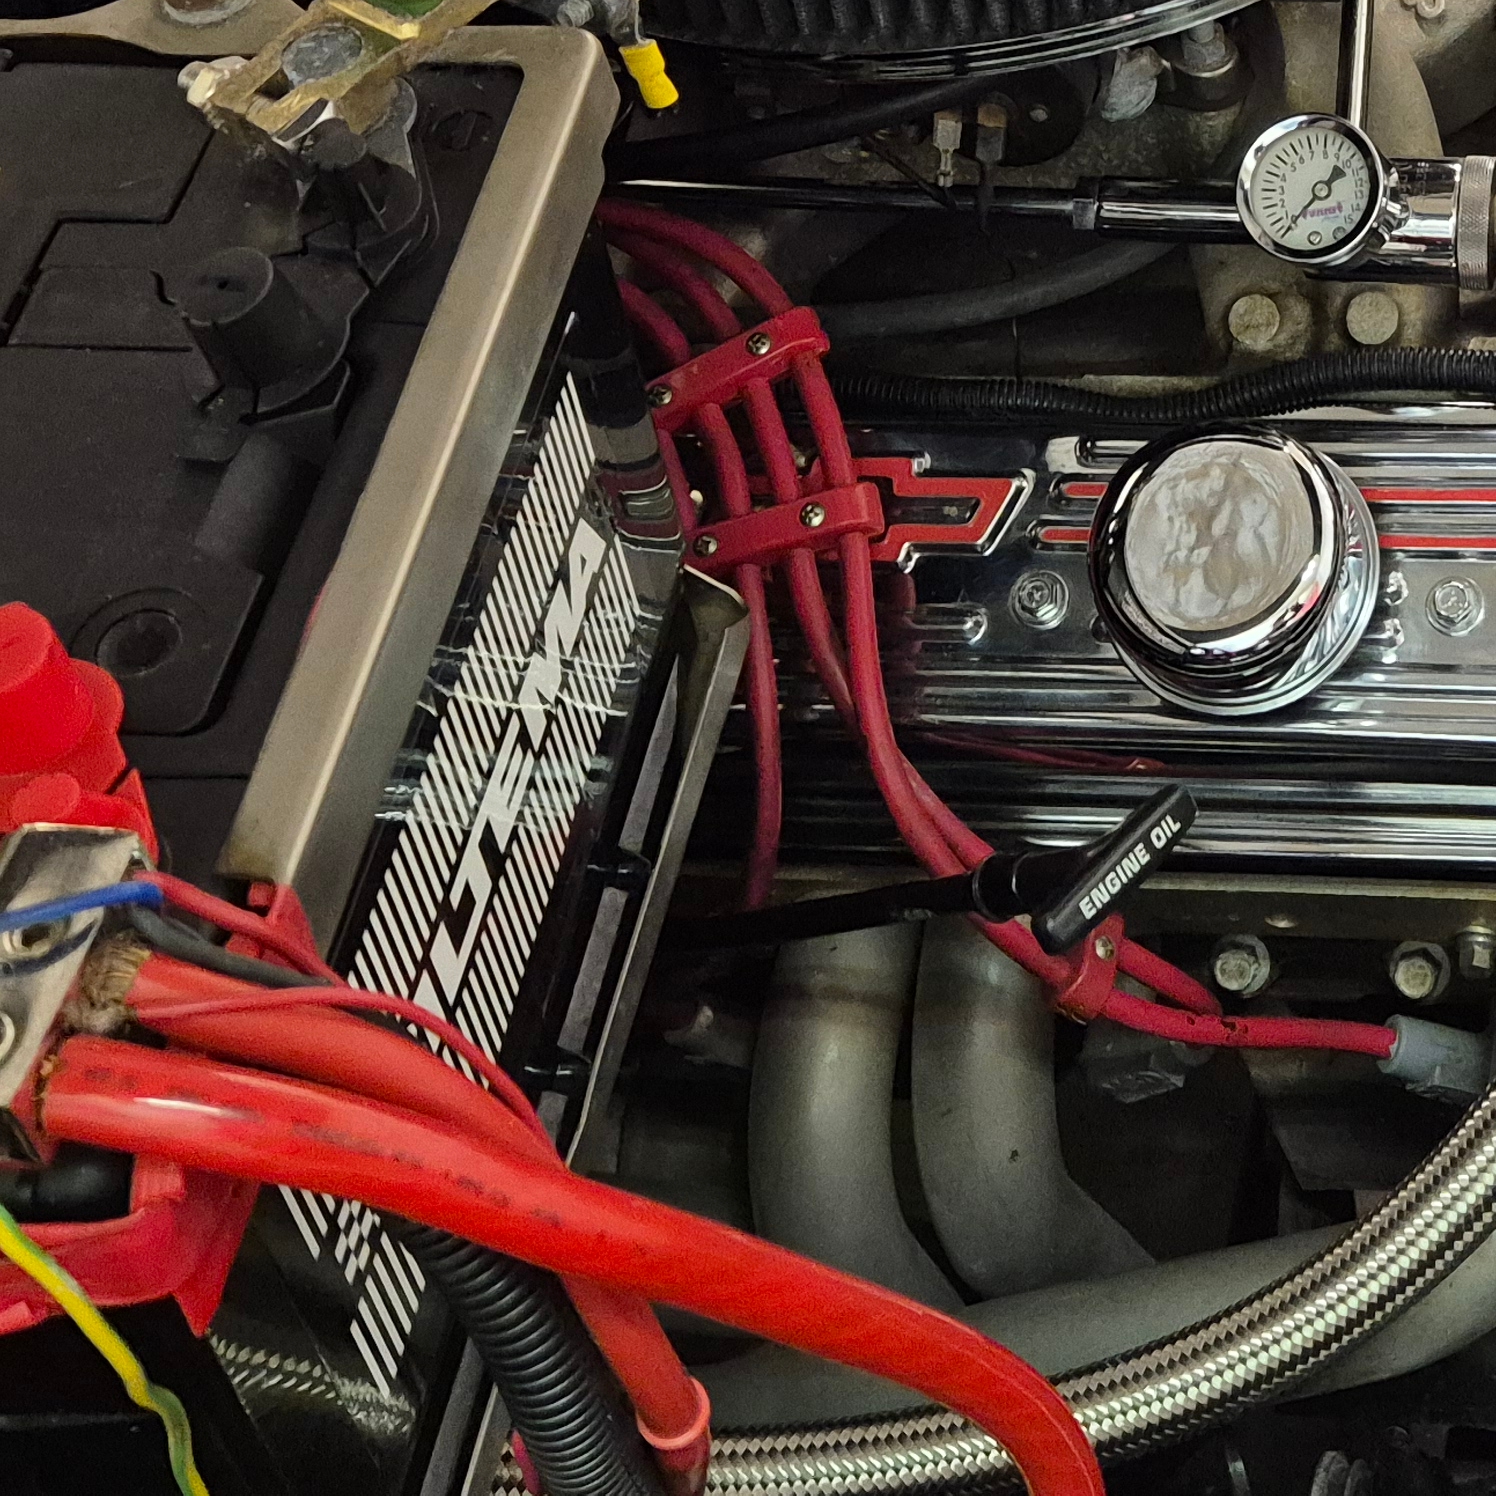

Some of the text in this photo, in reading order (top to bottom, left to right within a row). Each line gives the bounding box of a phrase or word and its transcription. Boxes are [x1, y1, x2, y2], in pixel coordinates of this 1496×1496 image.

[1342, 159, 1352, 169] 10
[1355, 178, 1364, 188] 12
[1355, 190, 1364, 200] 13
[1351, 203, 1360, 213] 14
[1344, 214, 1354, 224] 15
[1078, 814, 1182, 920] ENGINE OIL
